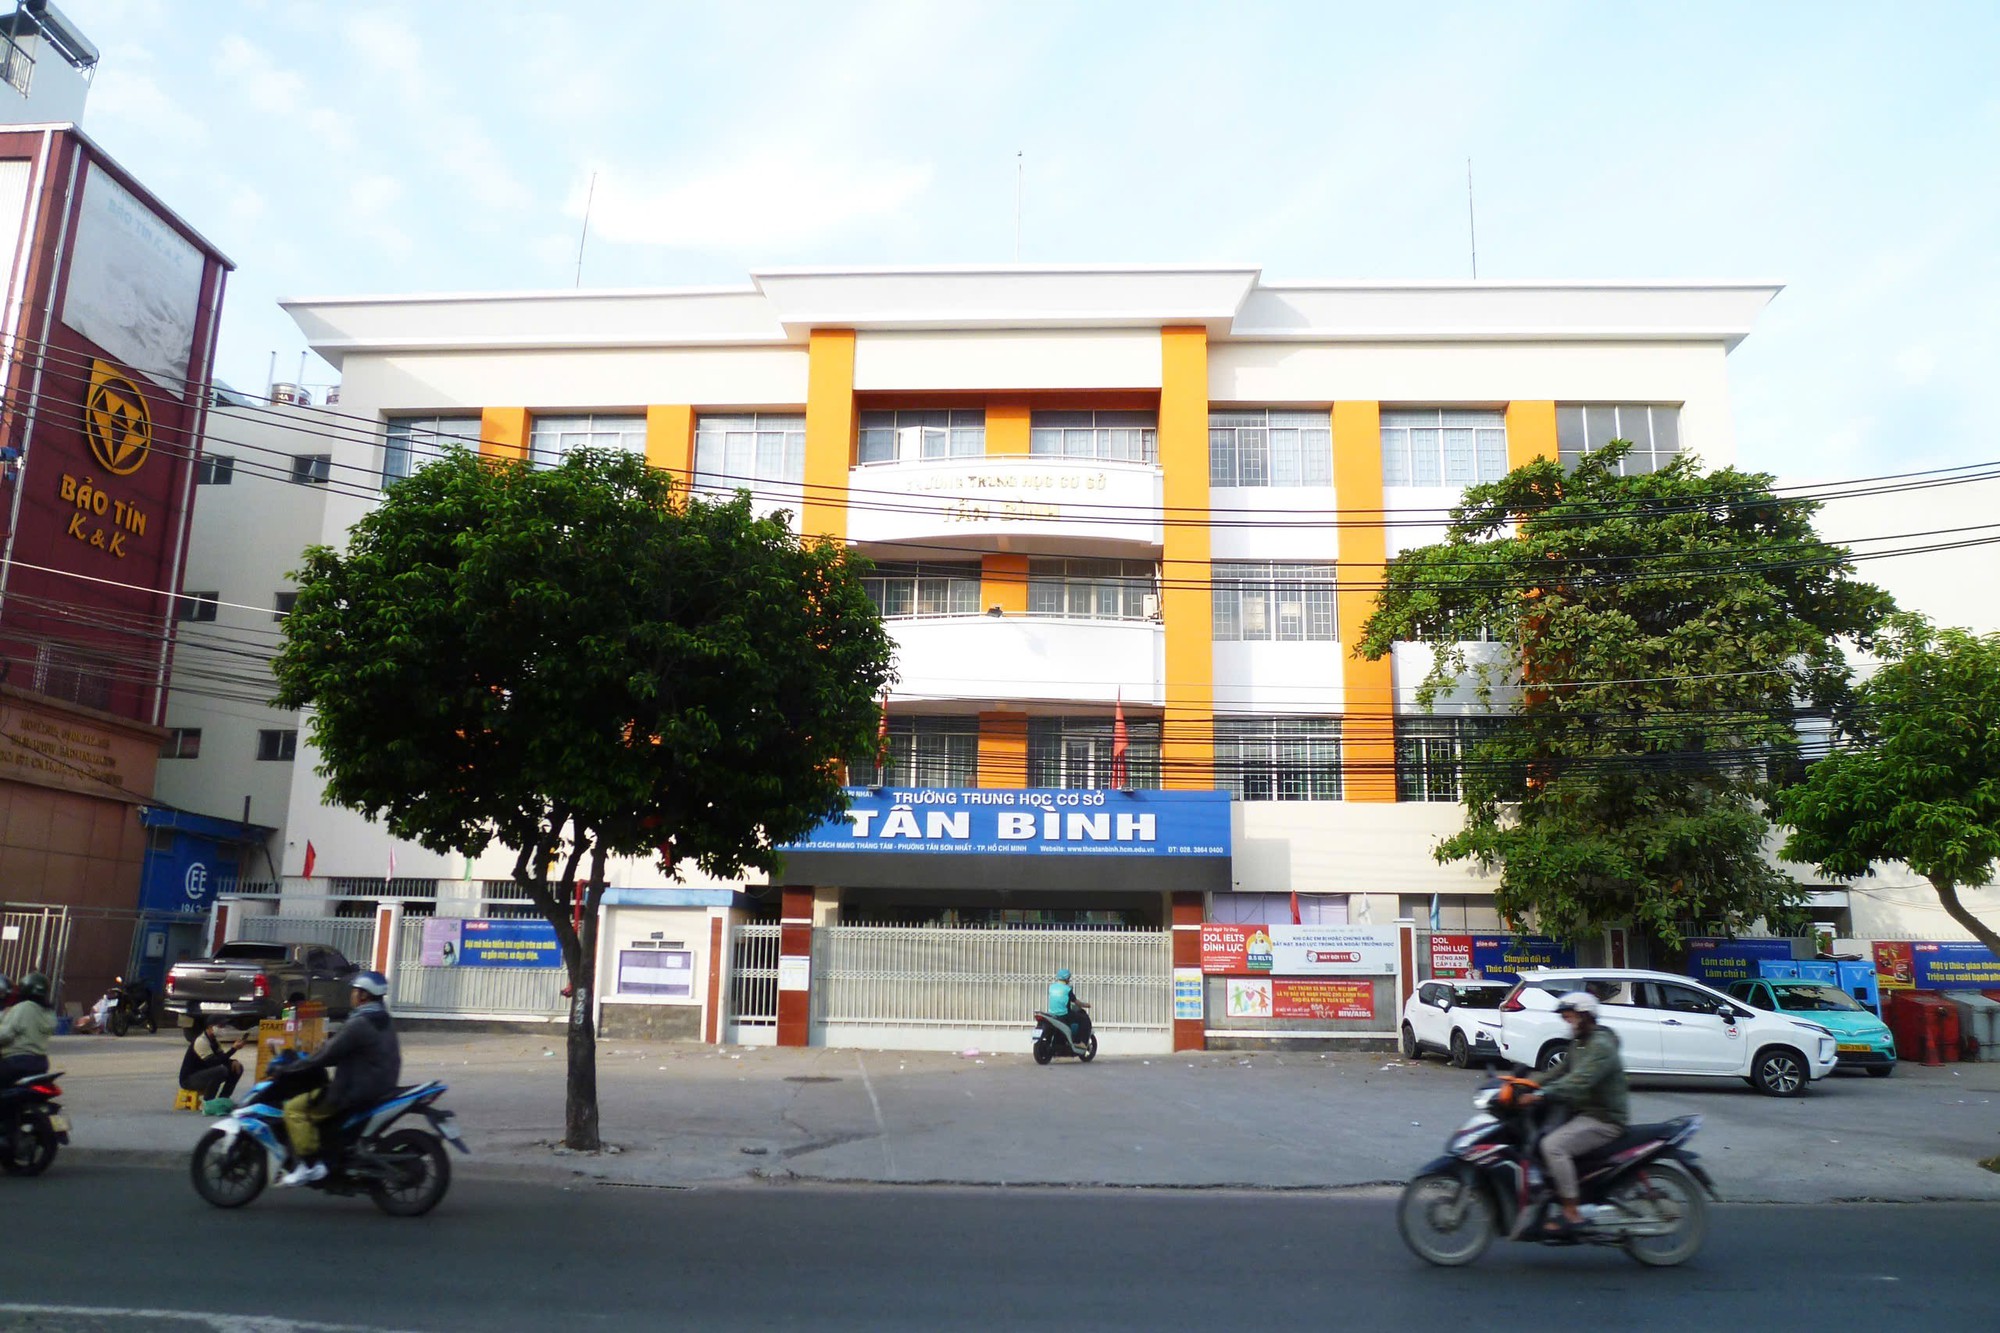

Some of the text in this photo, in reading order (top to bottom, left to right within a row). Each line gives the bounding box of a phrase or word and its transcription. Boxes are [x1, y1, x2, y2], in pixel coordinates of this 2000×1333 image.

[968, 475, 1016, 489] TRUNG
[60, 474, 147, 536] BẢO TÍN
[69, 512, 126, 558] K & K
[893, 789, 1106, 807] TRƯỜNG TRUNG HỌC CƠ SỞ
[845, 804, 1156, 841] TÂN BÌNH
[817, 841, 836, 849] CÁCH
[836, 841, 857, 850] MẠNG
[857, 841, 879, 850] THÁNG
[880, 841, 894, 850] TÁM
[898, 842, 925, 851] PHƯỜNG
[926, 842, 939, 851] TÂN
[940, 843, 953, 851] SƠN
[954, 842, 972, 851] NHẤT
[977, 844, 987, 852] TP.
[988, 842, 998, 852] HỒ
[999, 842, 1010, 852] CHÍ
[1010, 844, 1027, 852] MINH
[1040, 845, 1066, 853] Website:
[1203, 934, 1245, 942] DOL IELTS
[1432, 936, 1449, 945] DOL
[1203, 941, 1244, 953] ĐÌNH LỰC
[1432, 944, 1469, 953] ĐÌNH LỰC
[1338, 1010, 1372, 1018] HIV/AIDS
